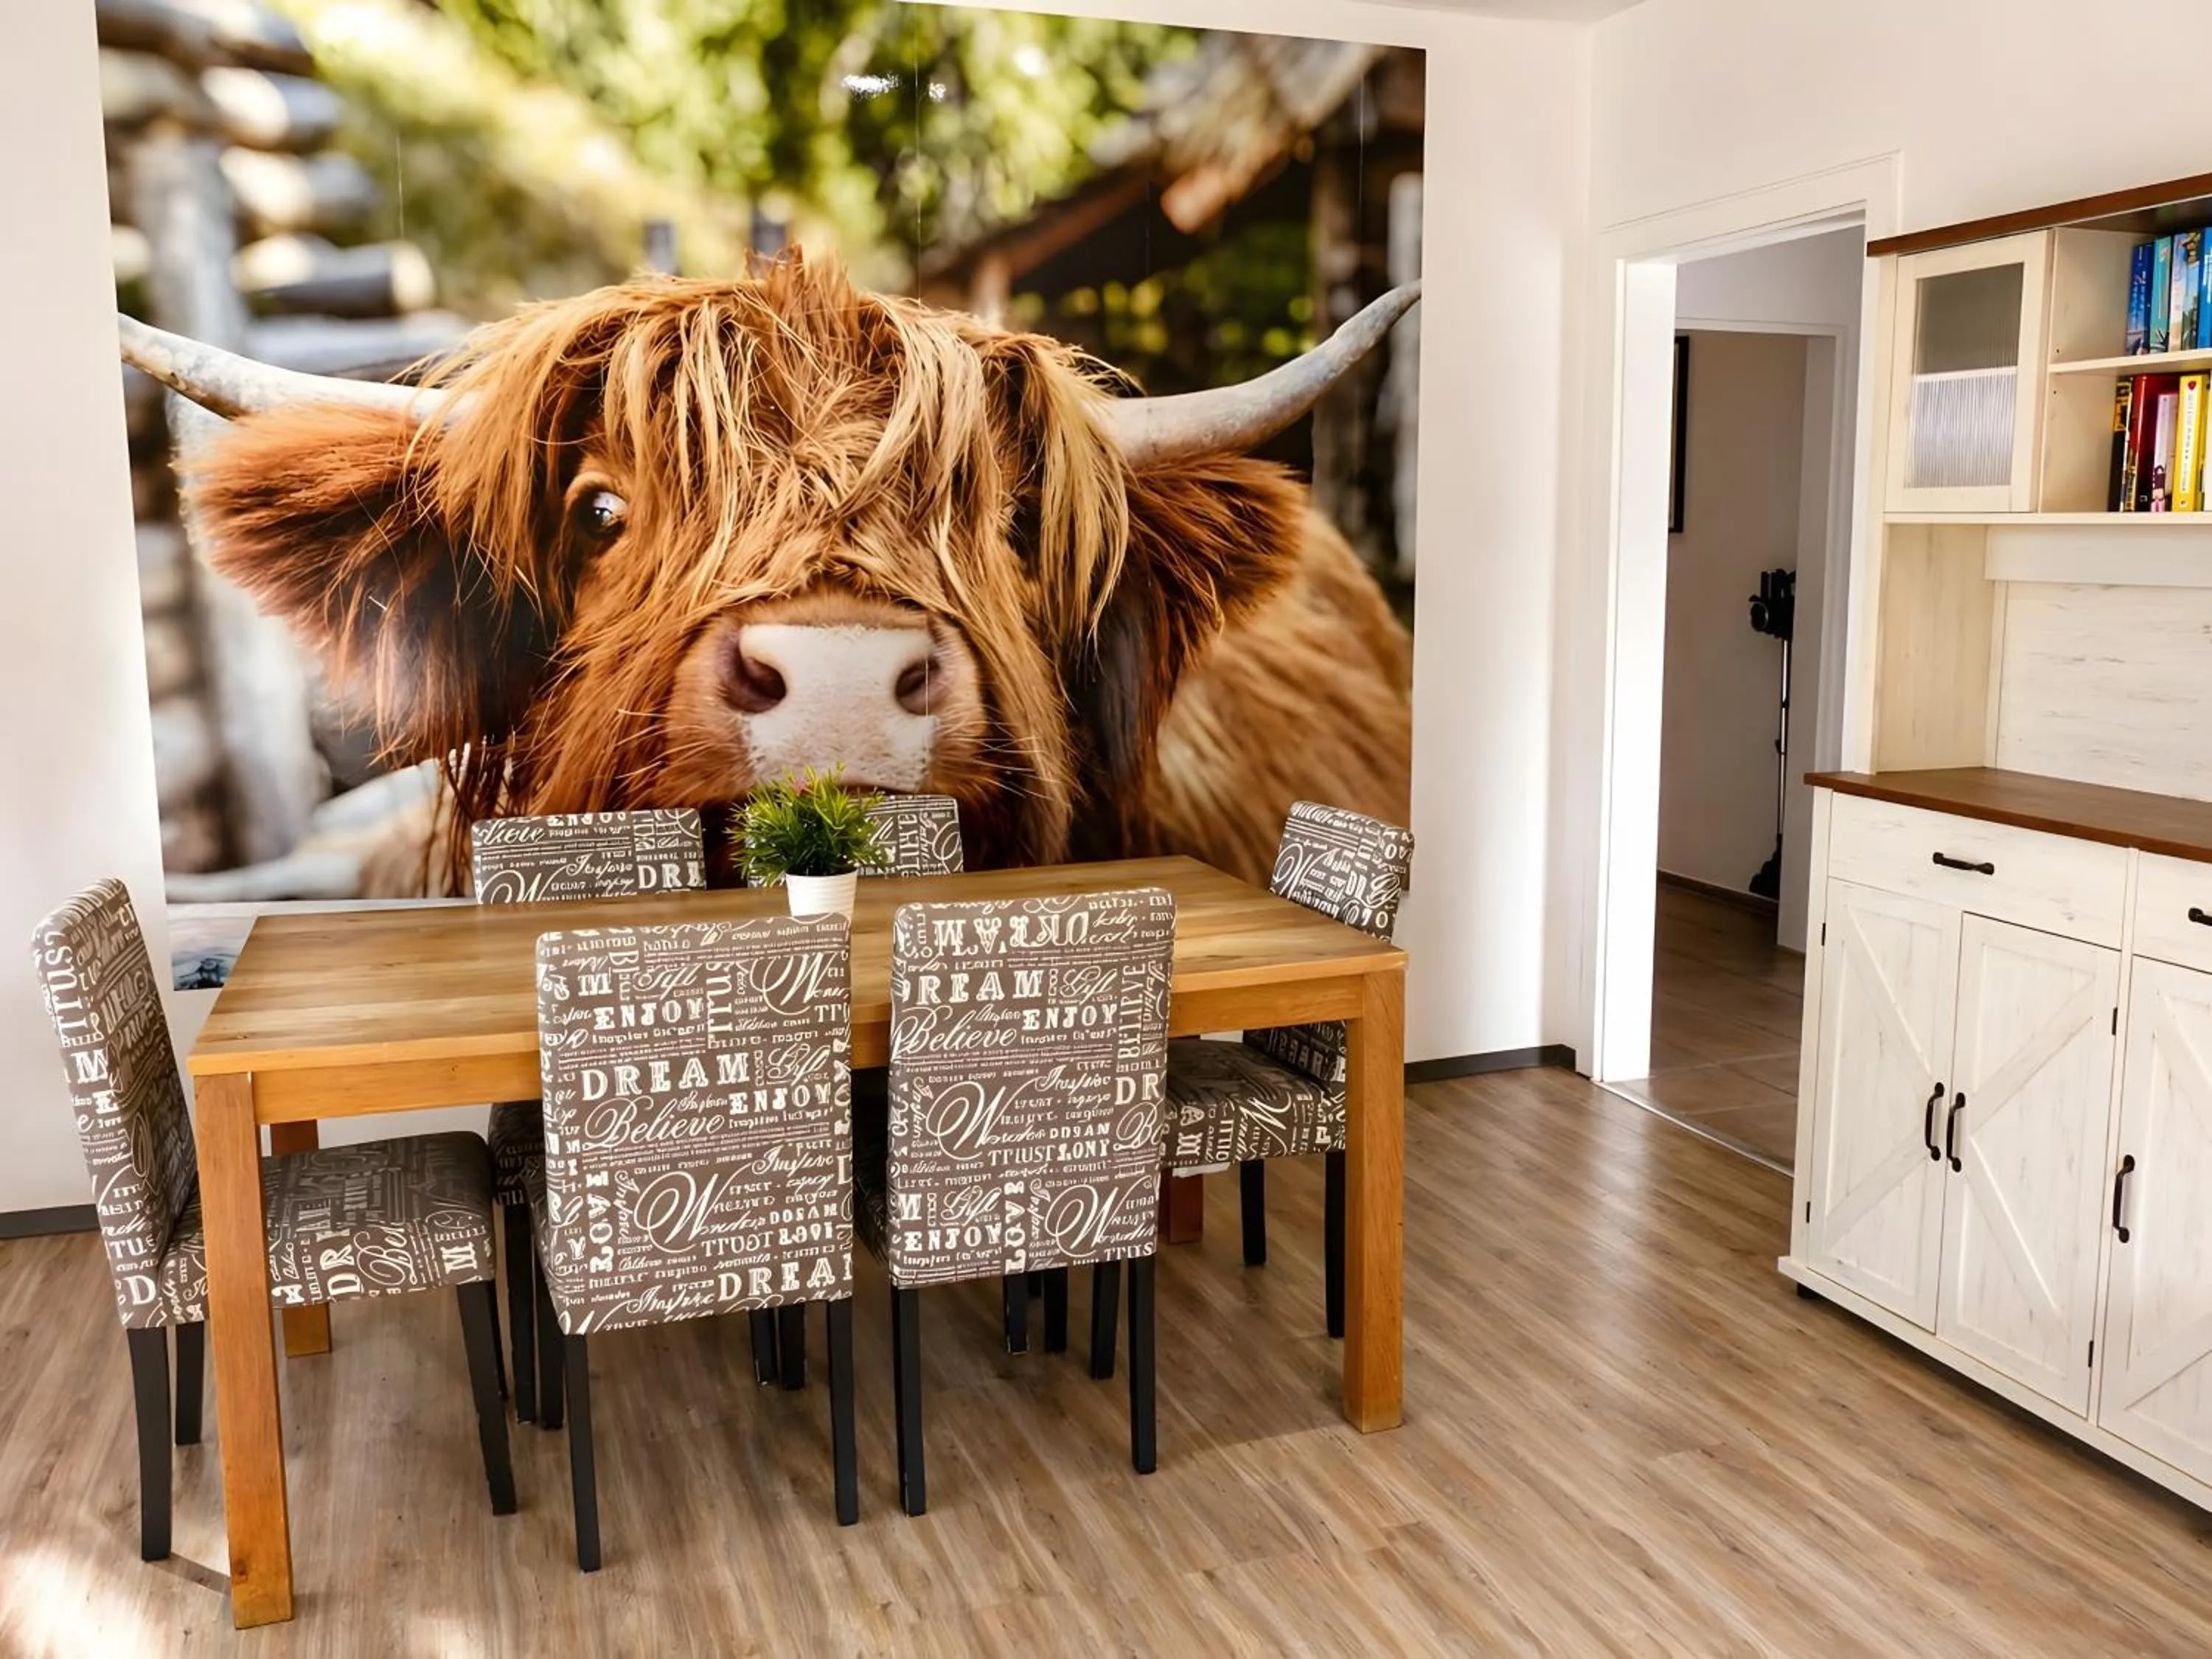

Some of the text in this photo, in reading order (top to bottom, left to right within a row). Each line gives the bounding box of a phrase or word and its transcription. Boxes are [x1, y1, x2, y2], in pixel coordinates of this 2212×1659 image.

[893, 1005, 1018, 1054] Believe
[1022, 1004, 1118, 1030] ENJOY
[581, 1051, 751, 1101] DREAM
[582, 1095, 725, 1149] Believe
[904, 1222, 1003, 1251] ENJOY
